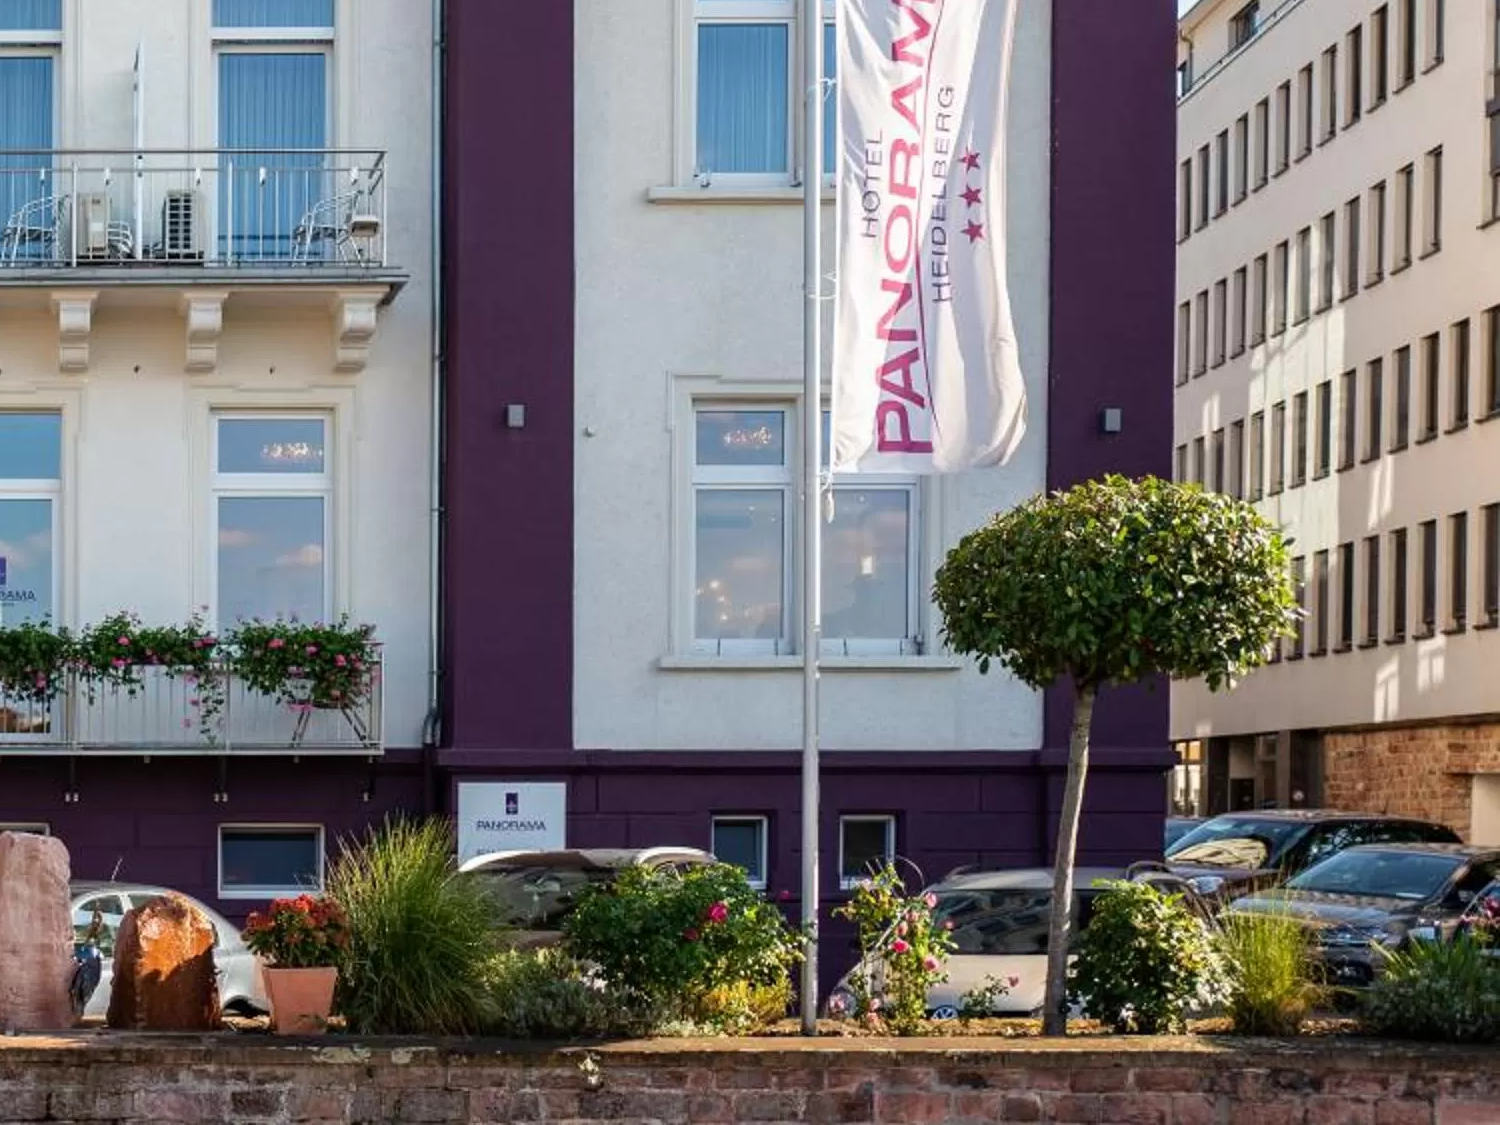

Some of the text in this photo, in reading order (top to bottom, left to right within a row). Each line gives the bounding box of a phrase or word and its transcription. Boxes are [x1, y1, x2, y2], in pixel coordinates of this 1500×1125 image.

[861, 128, 884, 239] HOTEL
[931, 84, 955, 304] HEIDELBERG
[476, 820, 546, 832] PANORAMA
